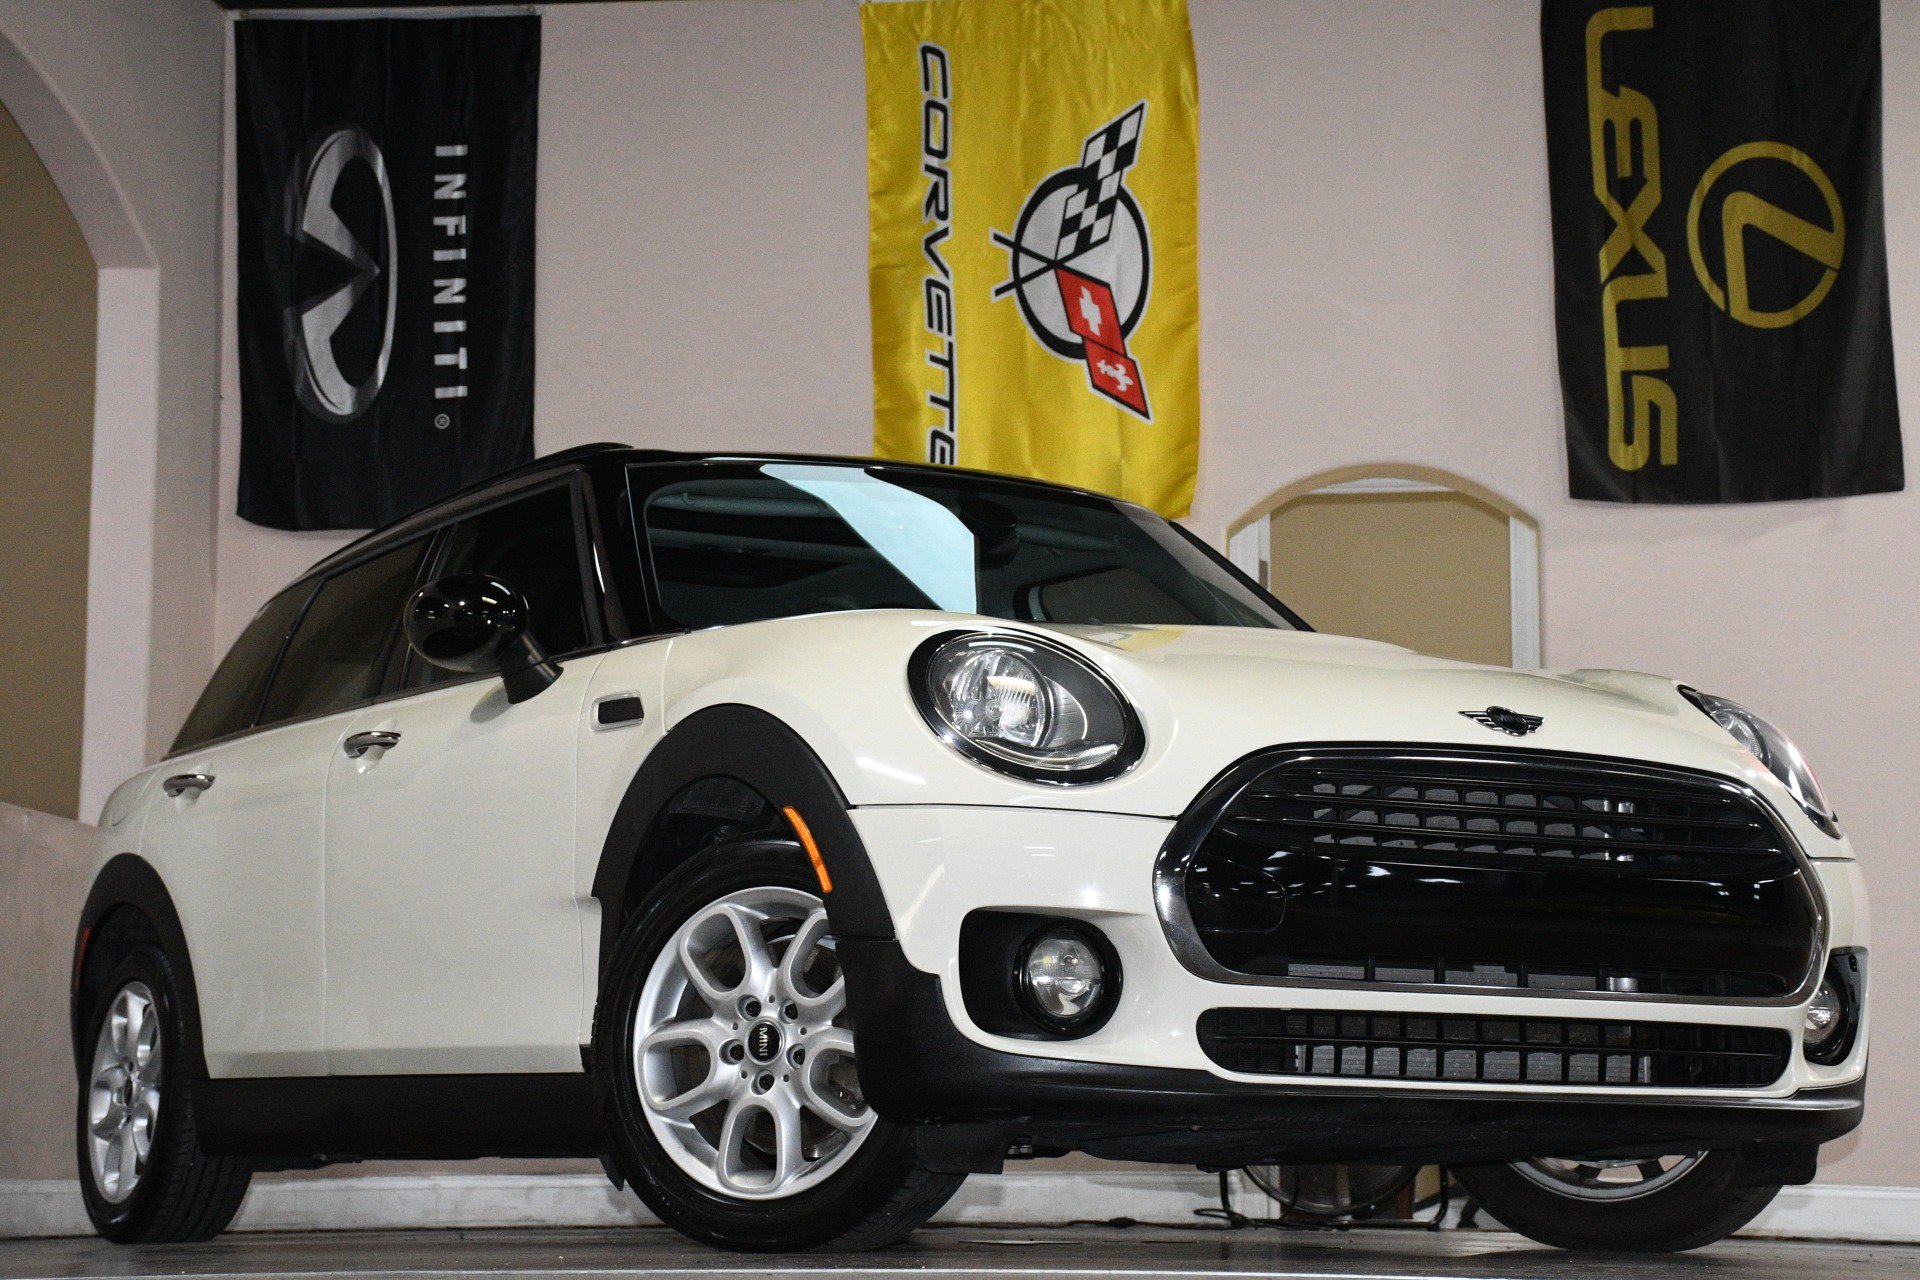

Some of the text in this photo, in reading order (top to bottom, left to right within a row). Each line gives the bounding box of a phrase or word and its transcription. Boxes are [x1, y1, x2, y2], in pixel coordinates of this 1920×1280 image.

[433, 144, 468, 400] INFINITI
[920, 44, 956, 465] CORVETTE
[1586, 6, 1678, 472] LEXUS
[759, 1027, 768, 1056] MINI
